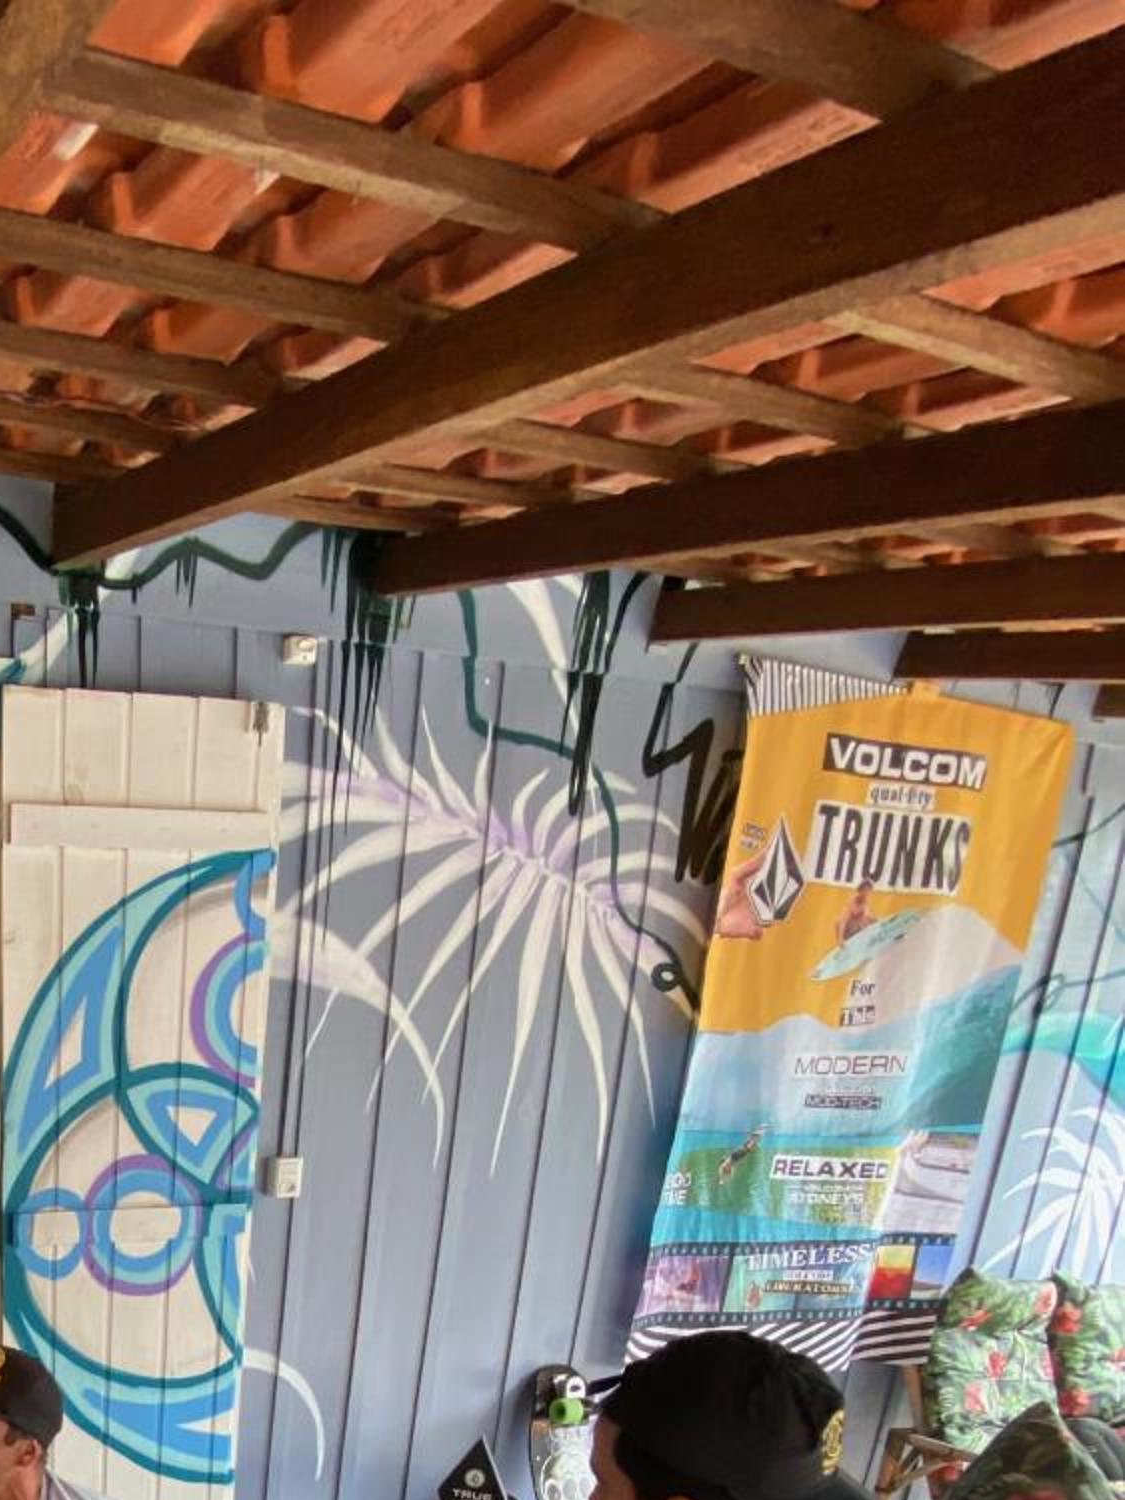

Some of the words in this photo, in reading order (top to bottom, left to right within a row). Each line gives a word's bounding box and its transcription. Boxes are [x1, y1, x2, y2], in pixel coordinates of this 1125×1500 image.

[830, 737, 987, 790] VOLCOM
[814, 803, 971, 892] TRUNKS
[851, 979, 875, 995] For
[795, 1055, 908, 1075] MODERN
[773, 1158, 890, 1179] RELAXED
[747, 1243, 871, 1270] TIMELESS
